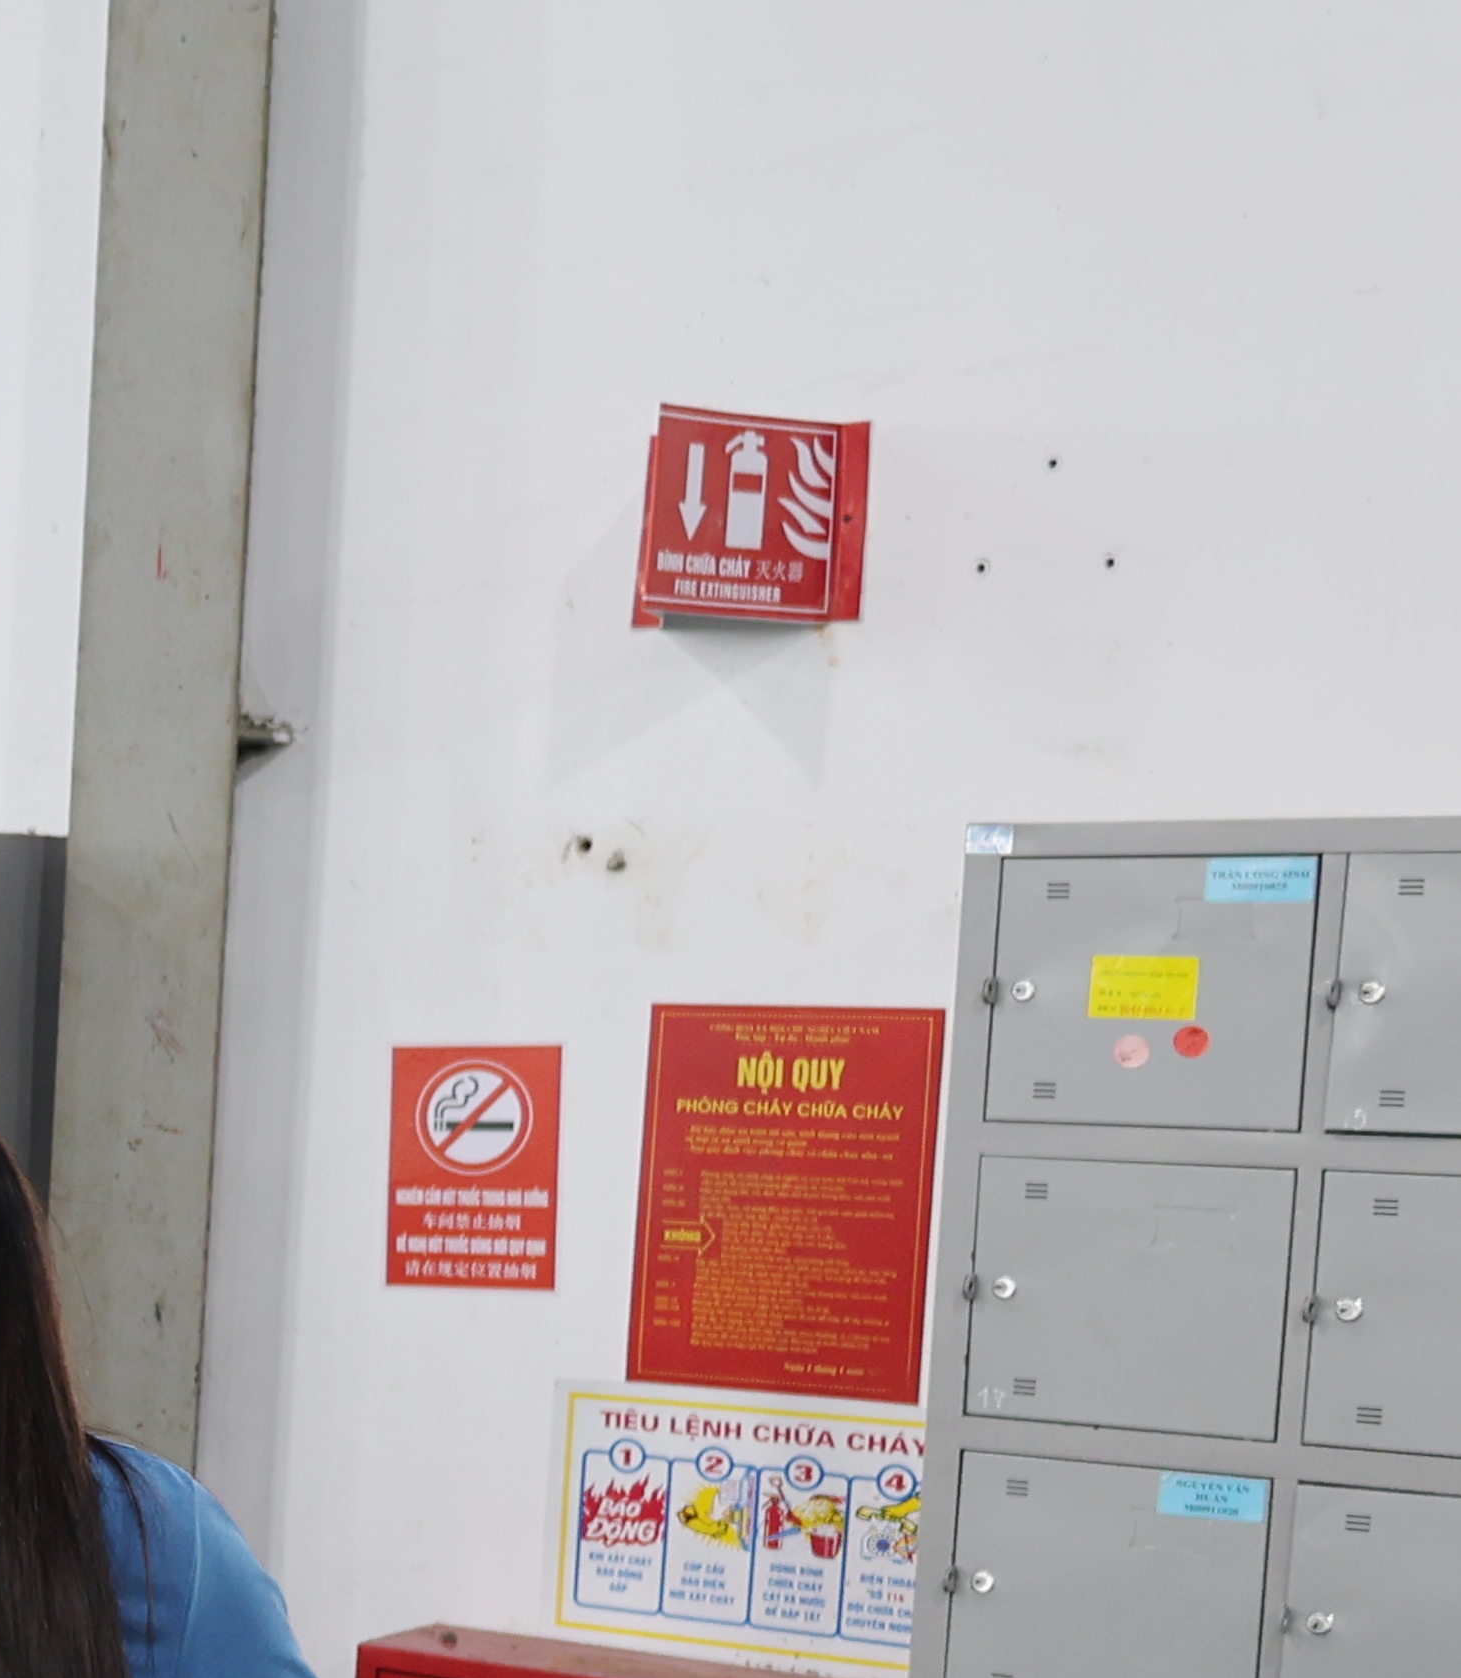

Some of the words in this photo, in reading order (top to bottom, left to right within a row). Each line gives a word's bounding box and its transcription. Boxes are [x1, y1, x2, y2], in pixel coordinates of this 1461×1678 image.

[719, 554, 751, 578] CHÁY
[674, 579, 697, 597] FIRE
[700, 580, 782, 602] EXTINGUISHER
[736, 1050, 785, 1095] NỘI
[791, 1057, 846, 1093] QUY
[743, 1098, 793, 1117] CHÁY
[797, 1101, 847, 1119] CHỮA
[852, 1102, 905, 1121] CHÁY
[600, 1408, 660, 1433] TIÊU
[669, 1414, 742, 1442] LỆNH
[752, 1423, 836, 1450] CHỮA
[847, 1429, 926, 1456] CHÁY
[619, 1447, 634, 1465] 1
[704, 1456, 724, 1474] 2
[794, 1464, 813, 1483] 3
[884, 1473, 906, 1492] 4
[599, 1497, 643, 1517] BÁO
[587, 1516, 657, 1545] ĐỘNG
